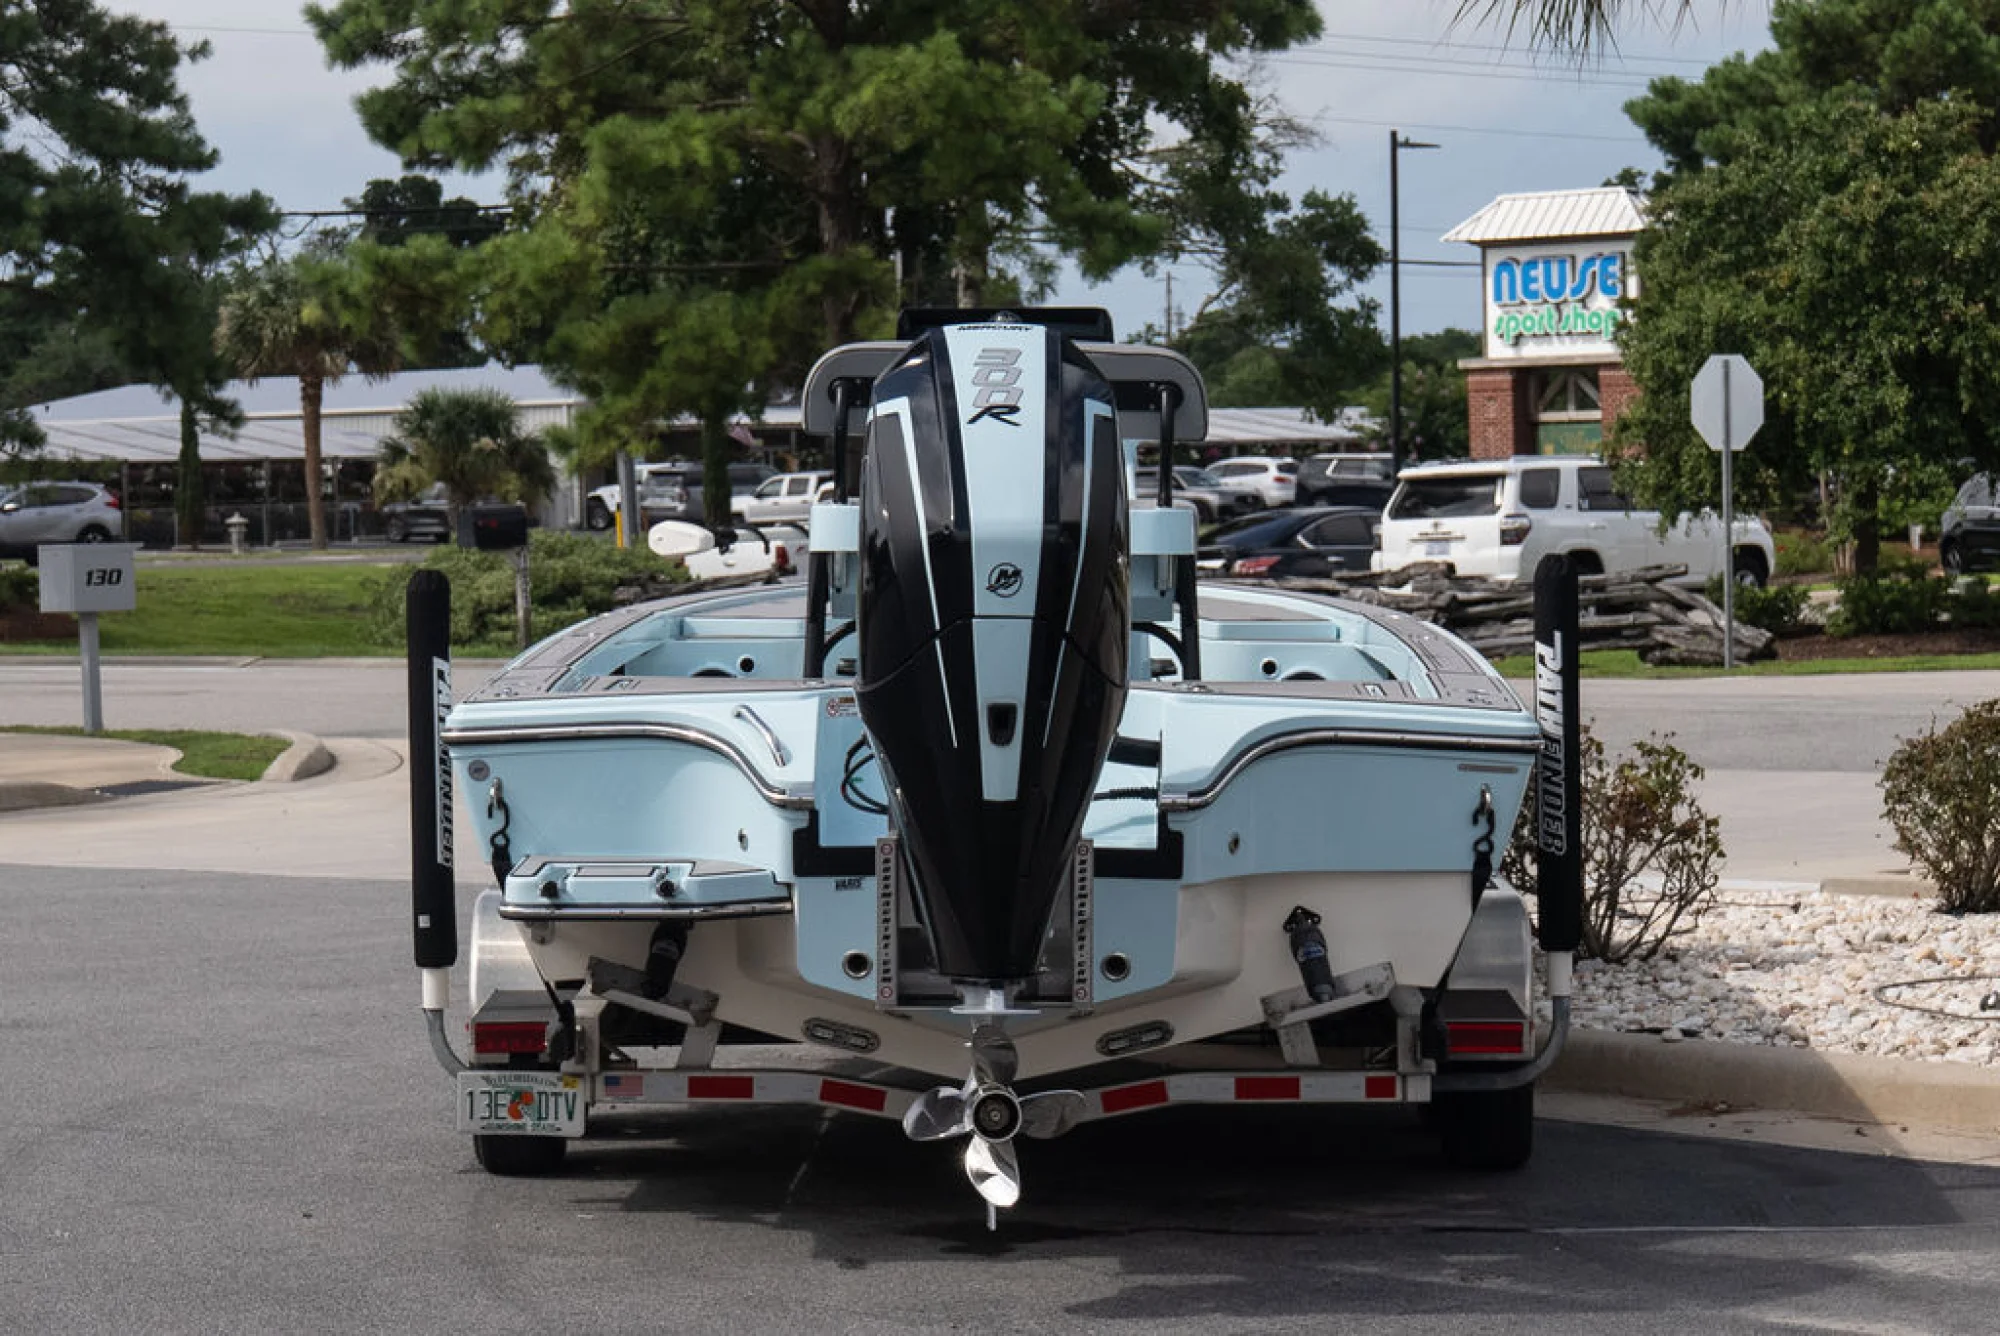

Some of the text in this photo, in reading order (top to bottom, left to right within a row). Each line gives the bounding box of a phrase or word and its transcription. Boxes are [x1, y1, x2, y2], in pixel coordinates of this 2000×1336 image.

[1493, 255, 1620, 302] NEUSE
[1494, 303, 1556, 344] sport
[85, 567, 122, 587] 130
[435, 657, 454, 867] PAFINDER
[1534, 629, 1567, 856] PATHFINDER
[466, 1090, 577, 1121] 13E DTV
